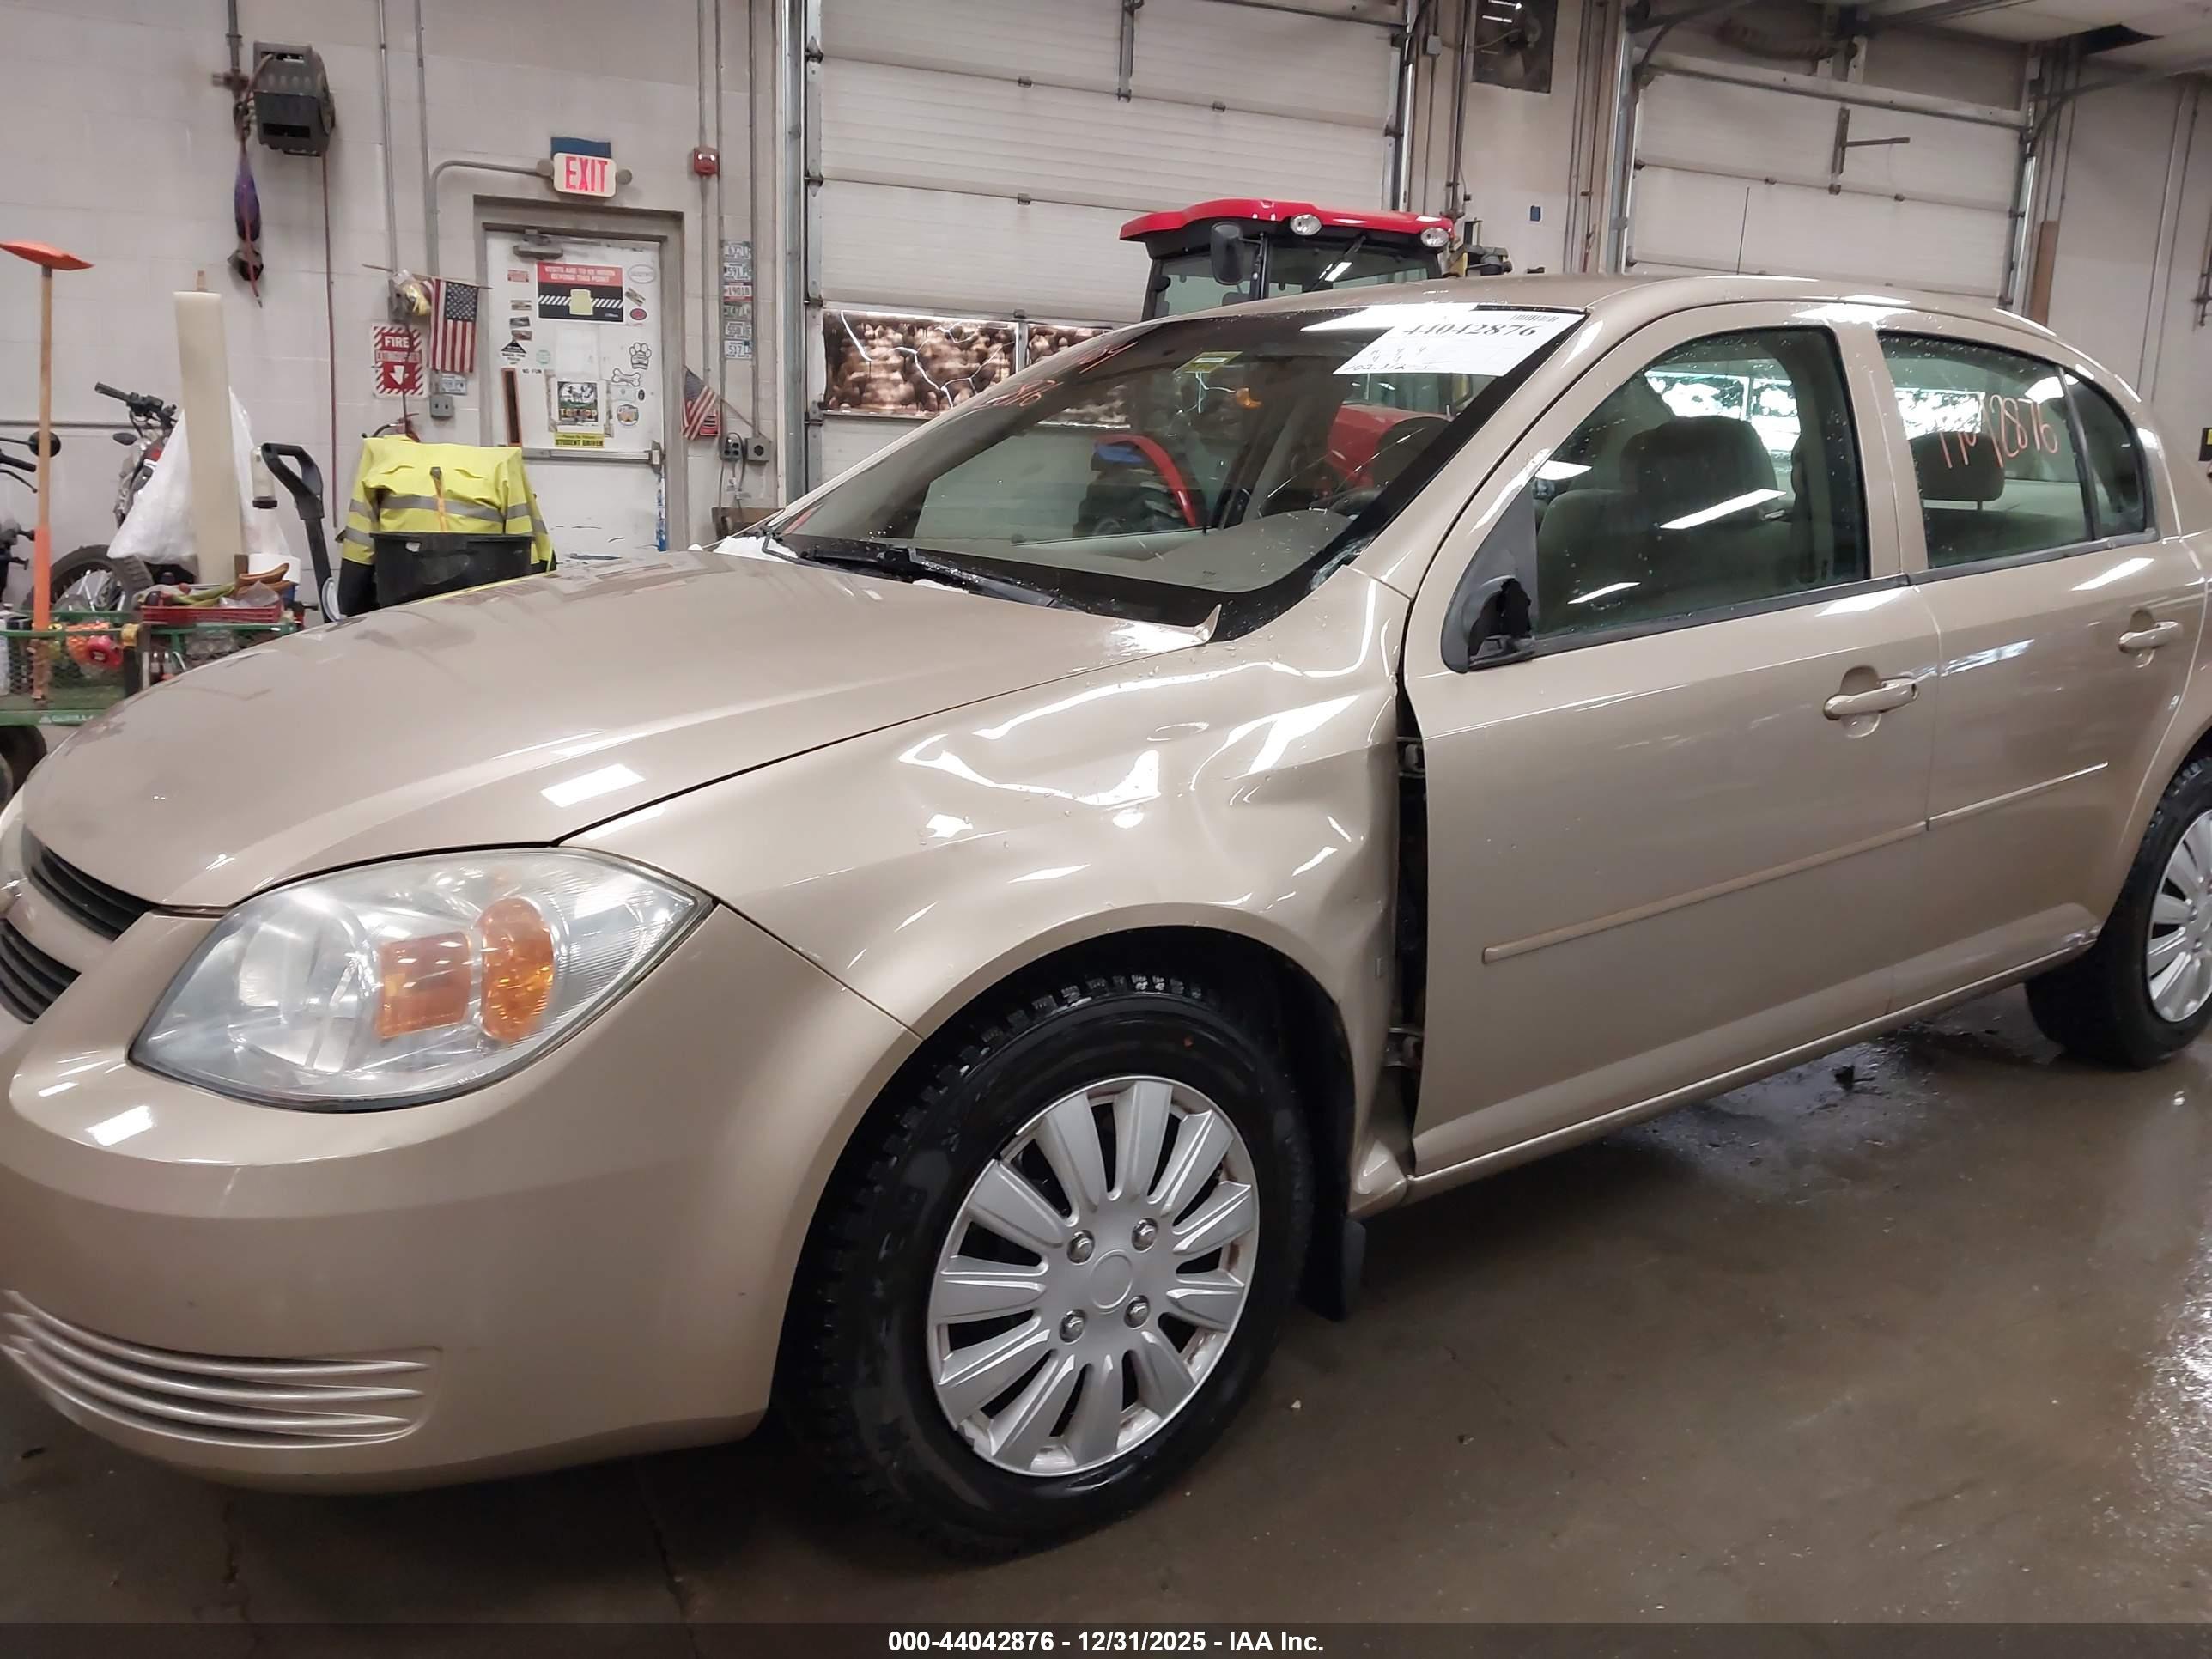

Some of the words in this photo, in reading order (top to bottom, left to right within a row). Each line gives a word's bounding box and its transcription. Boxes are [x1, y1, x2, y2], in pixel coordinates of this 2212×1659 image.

[565, 156, 608, 192] EXIT
[1402, 323, 1542, 337] 44042876
[384, 336, 410, 349] FIRE
